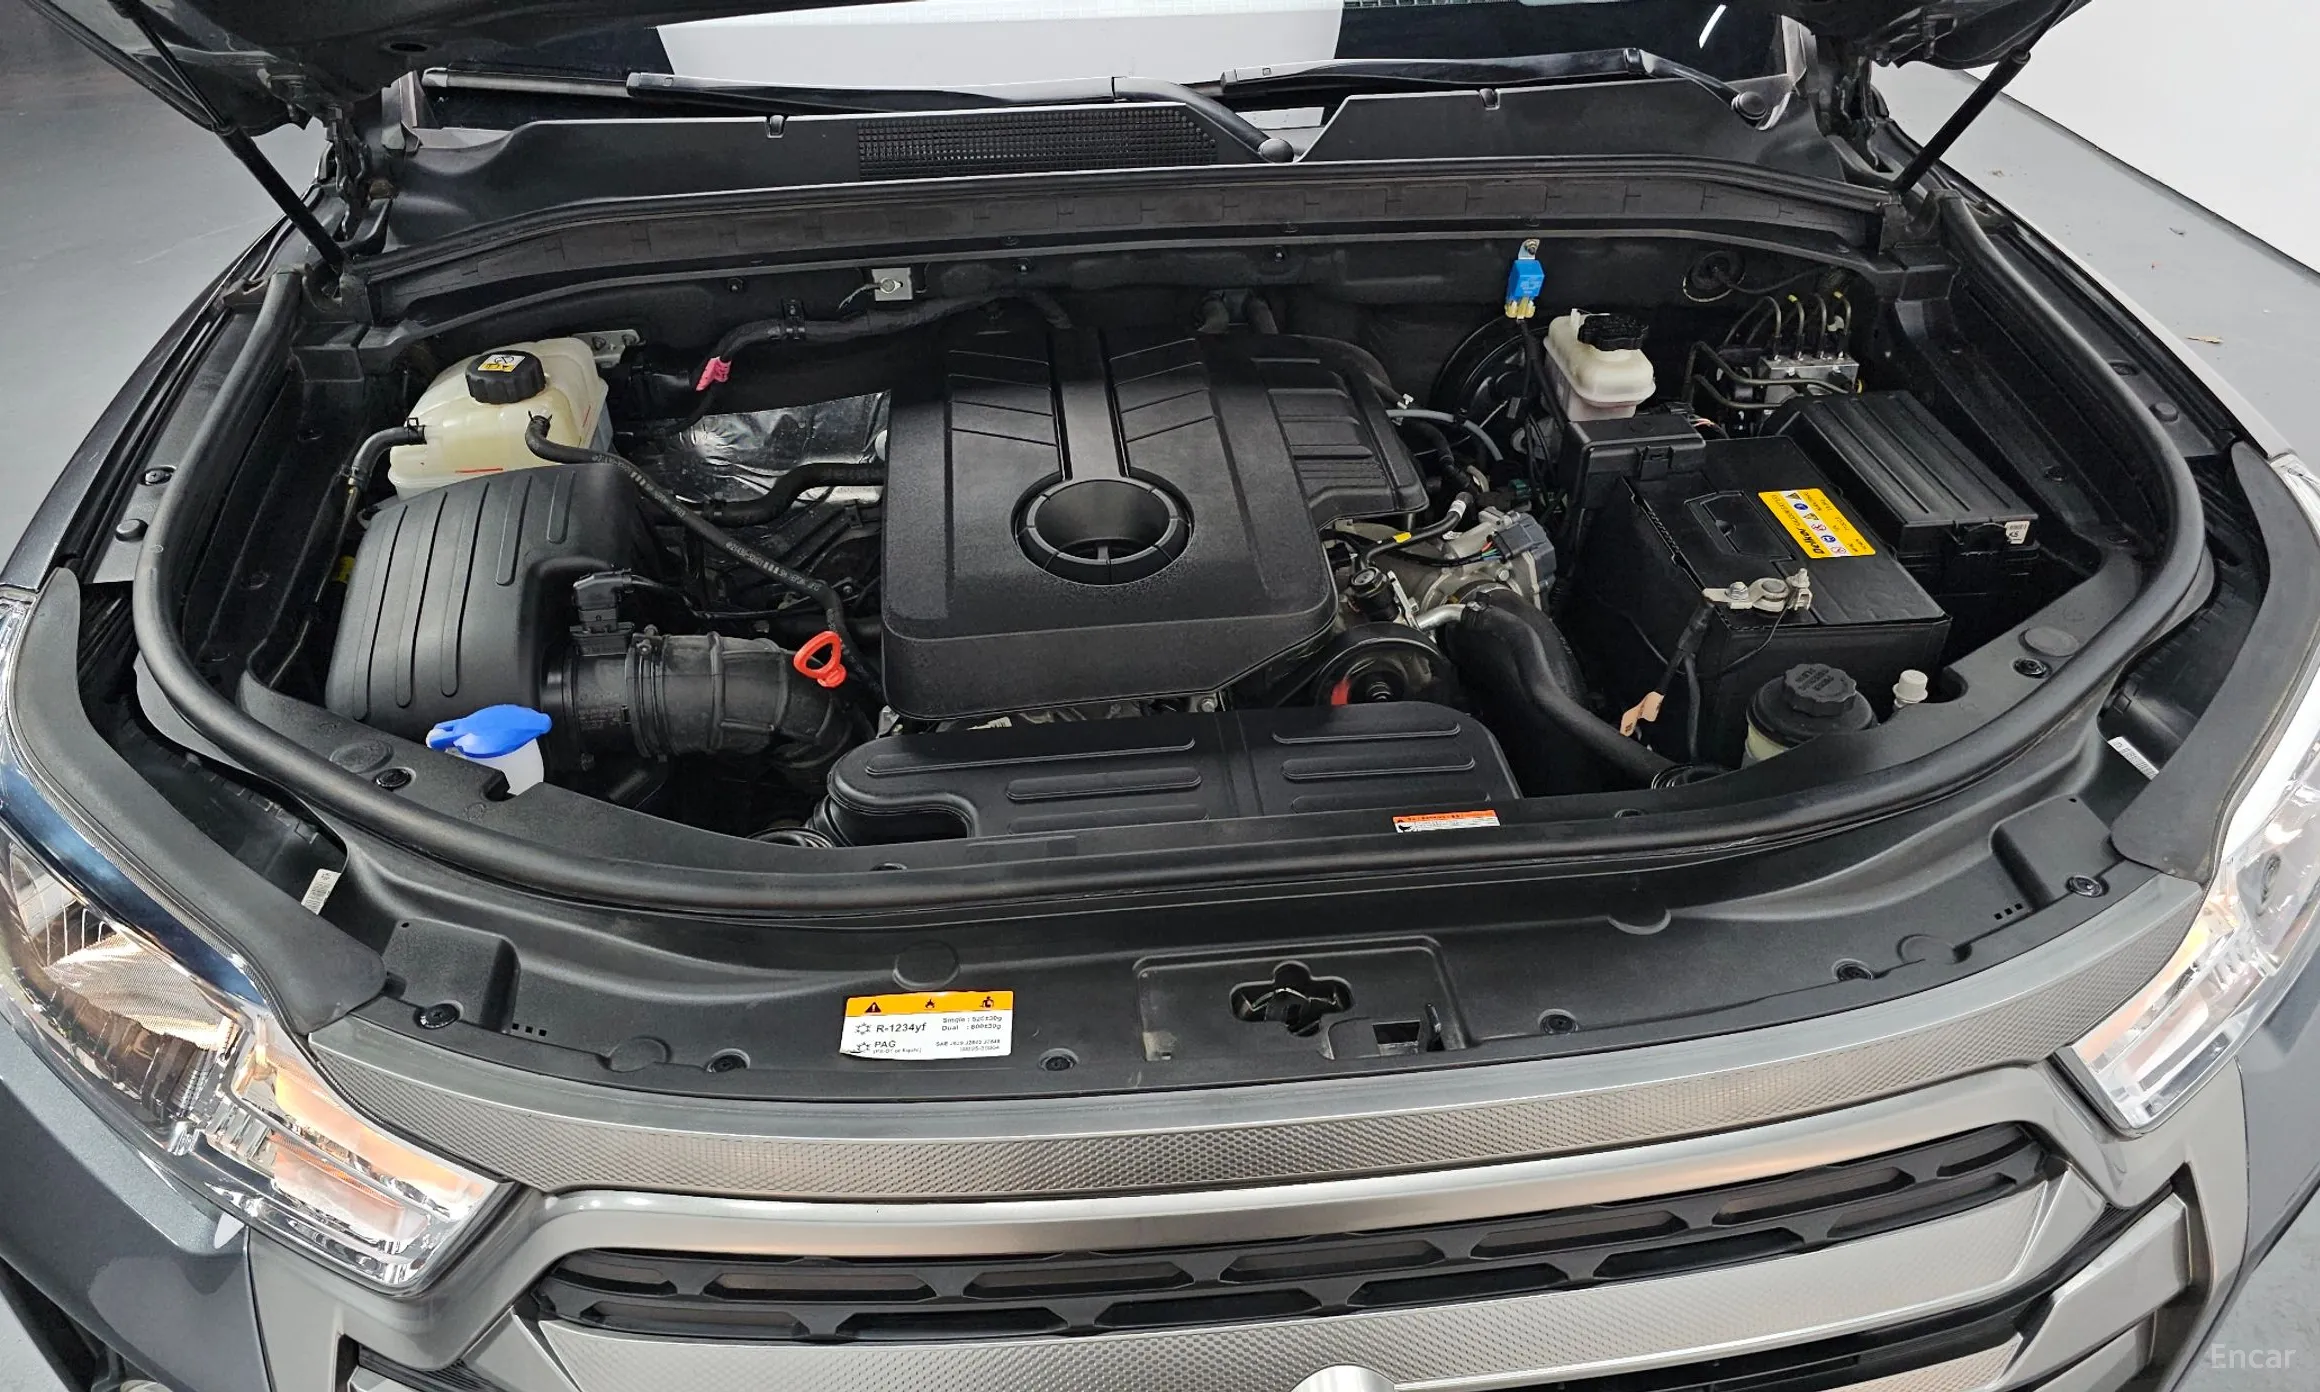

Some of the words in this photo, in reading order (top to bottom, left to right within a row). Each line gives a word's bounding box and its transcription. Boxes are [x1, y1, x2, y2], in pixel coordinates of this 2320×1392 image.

[876, 1022, 928, 1034] R-1234yf
[941, 1024, 959, 1032] Dual
[874, 1040, 897, 1048] PAG
